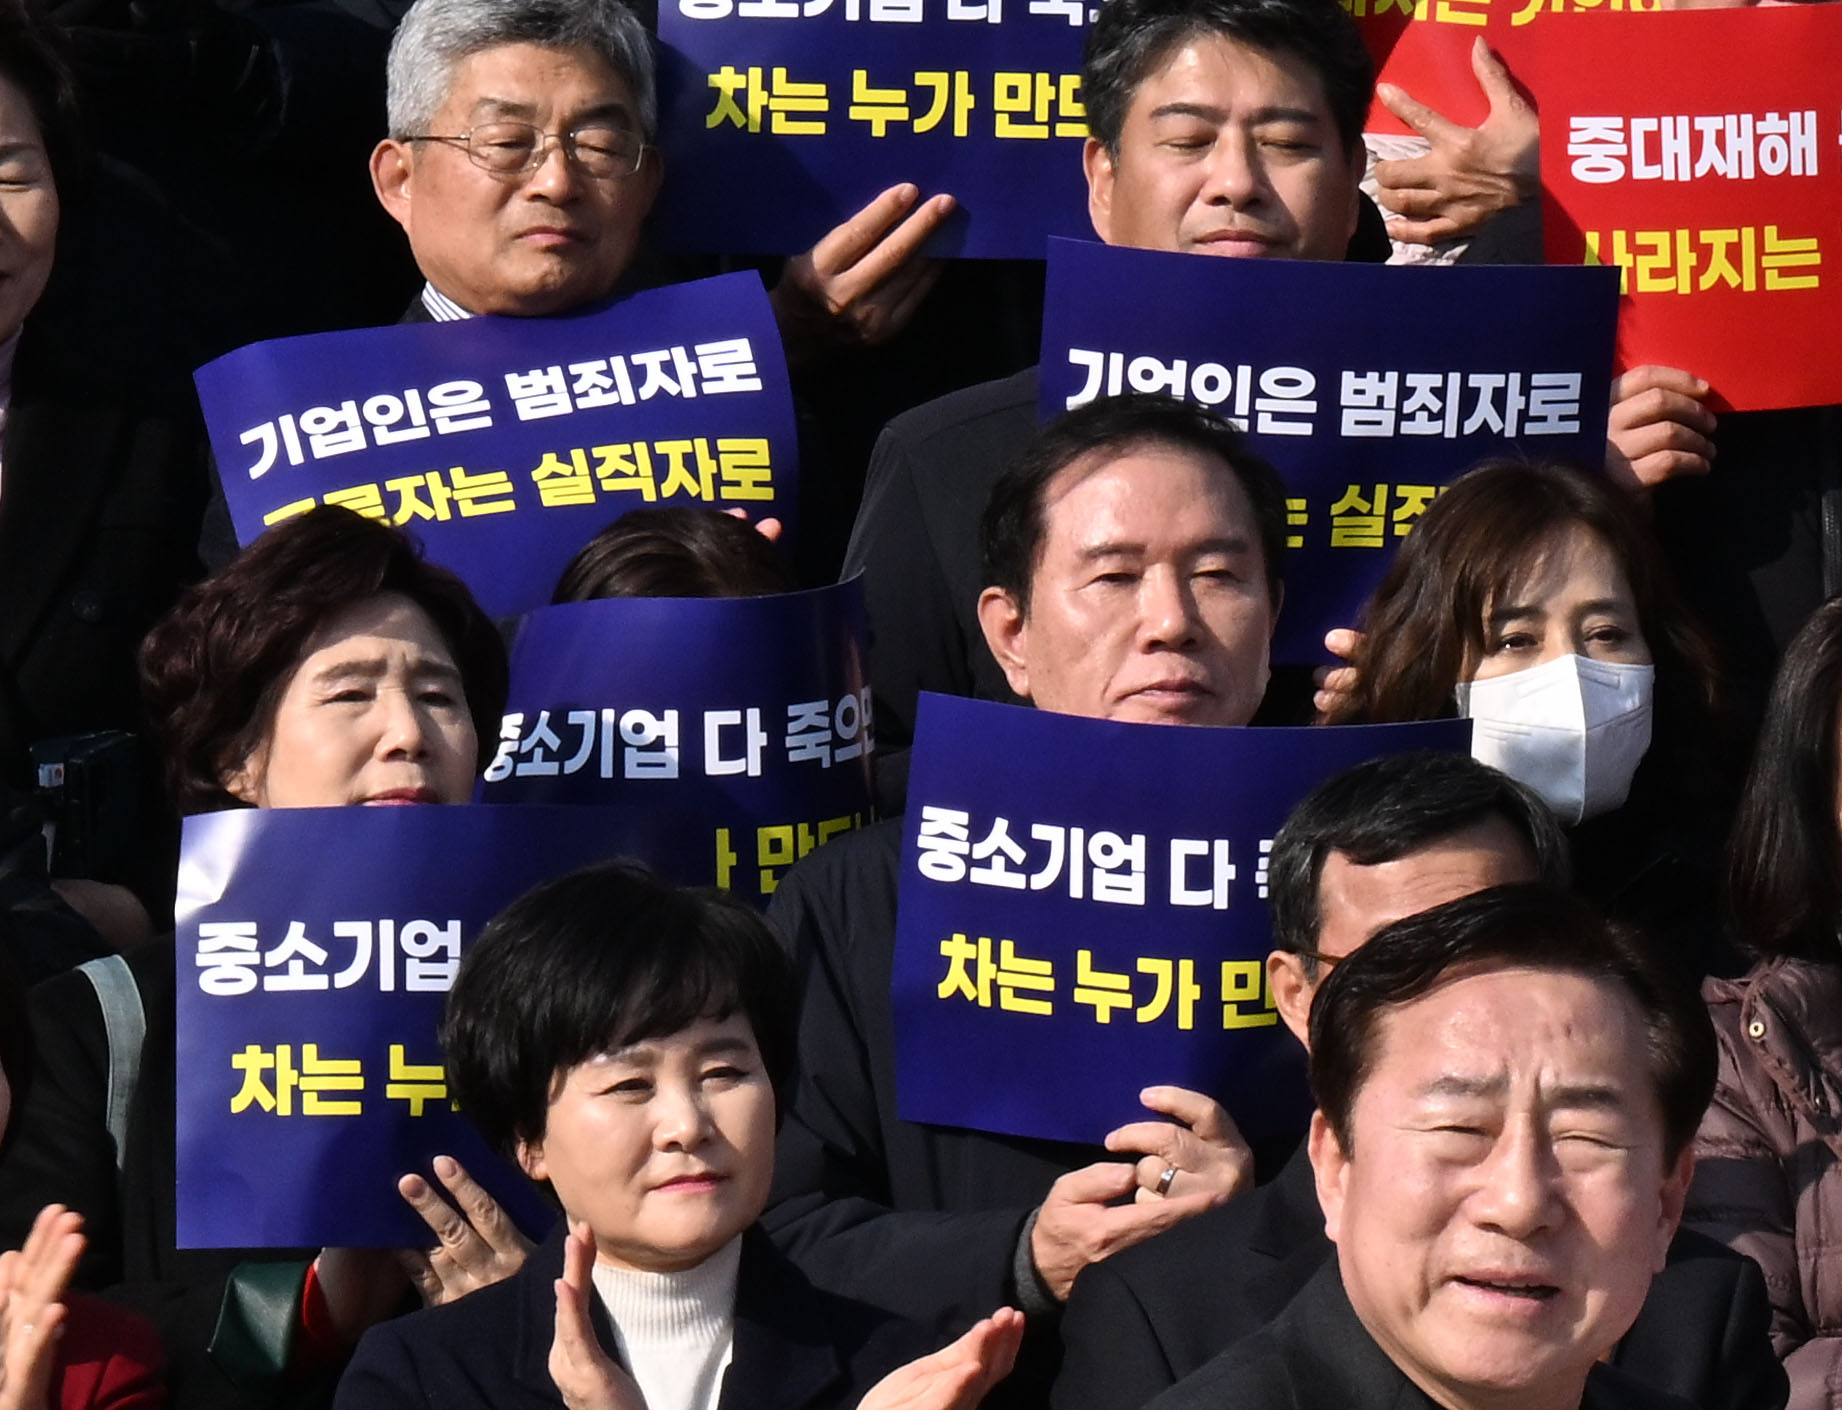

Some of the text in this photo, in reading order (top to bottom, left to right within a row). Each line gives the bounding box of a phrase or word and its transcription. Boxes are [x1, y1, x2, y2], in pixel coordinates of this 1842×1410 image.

[708, 66, 830, 135] 차는
[849, 69, 975, 137] 누가
[1567, 110, 1818, 184] 중대재해
[239, 337, 763, 481] 기업인은 범죄자로
[1340, 370, 1582, 439] 범죄자로
[532, 438, 775, 507] 실직자로
[703, 707, 768, 777] 다
[916, 805, 1146, 906] 중소기업
[1169, 838, 1236, 910] 다
[195, 918, 462, 997] 중소기업
[938, 933, 1055, 1015] 차는
[1074, 949, 1201, 1030] 누가
[231, 1043, 447, 1117] 차는 누
